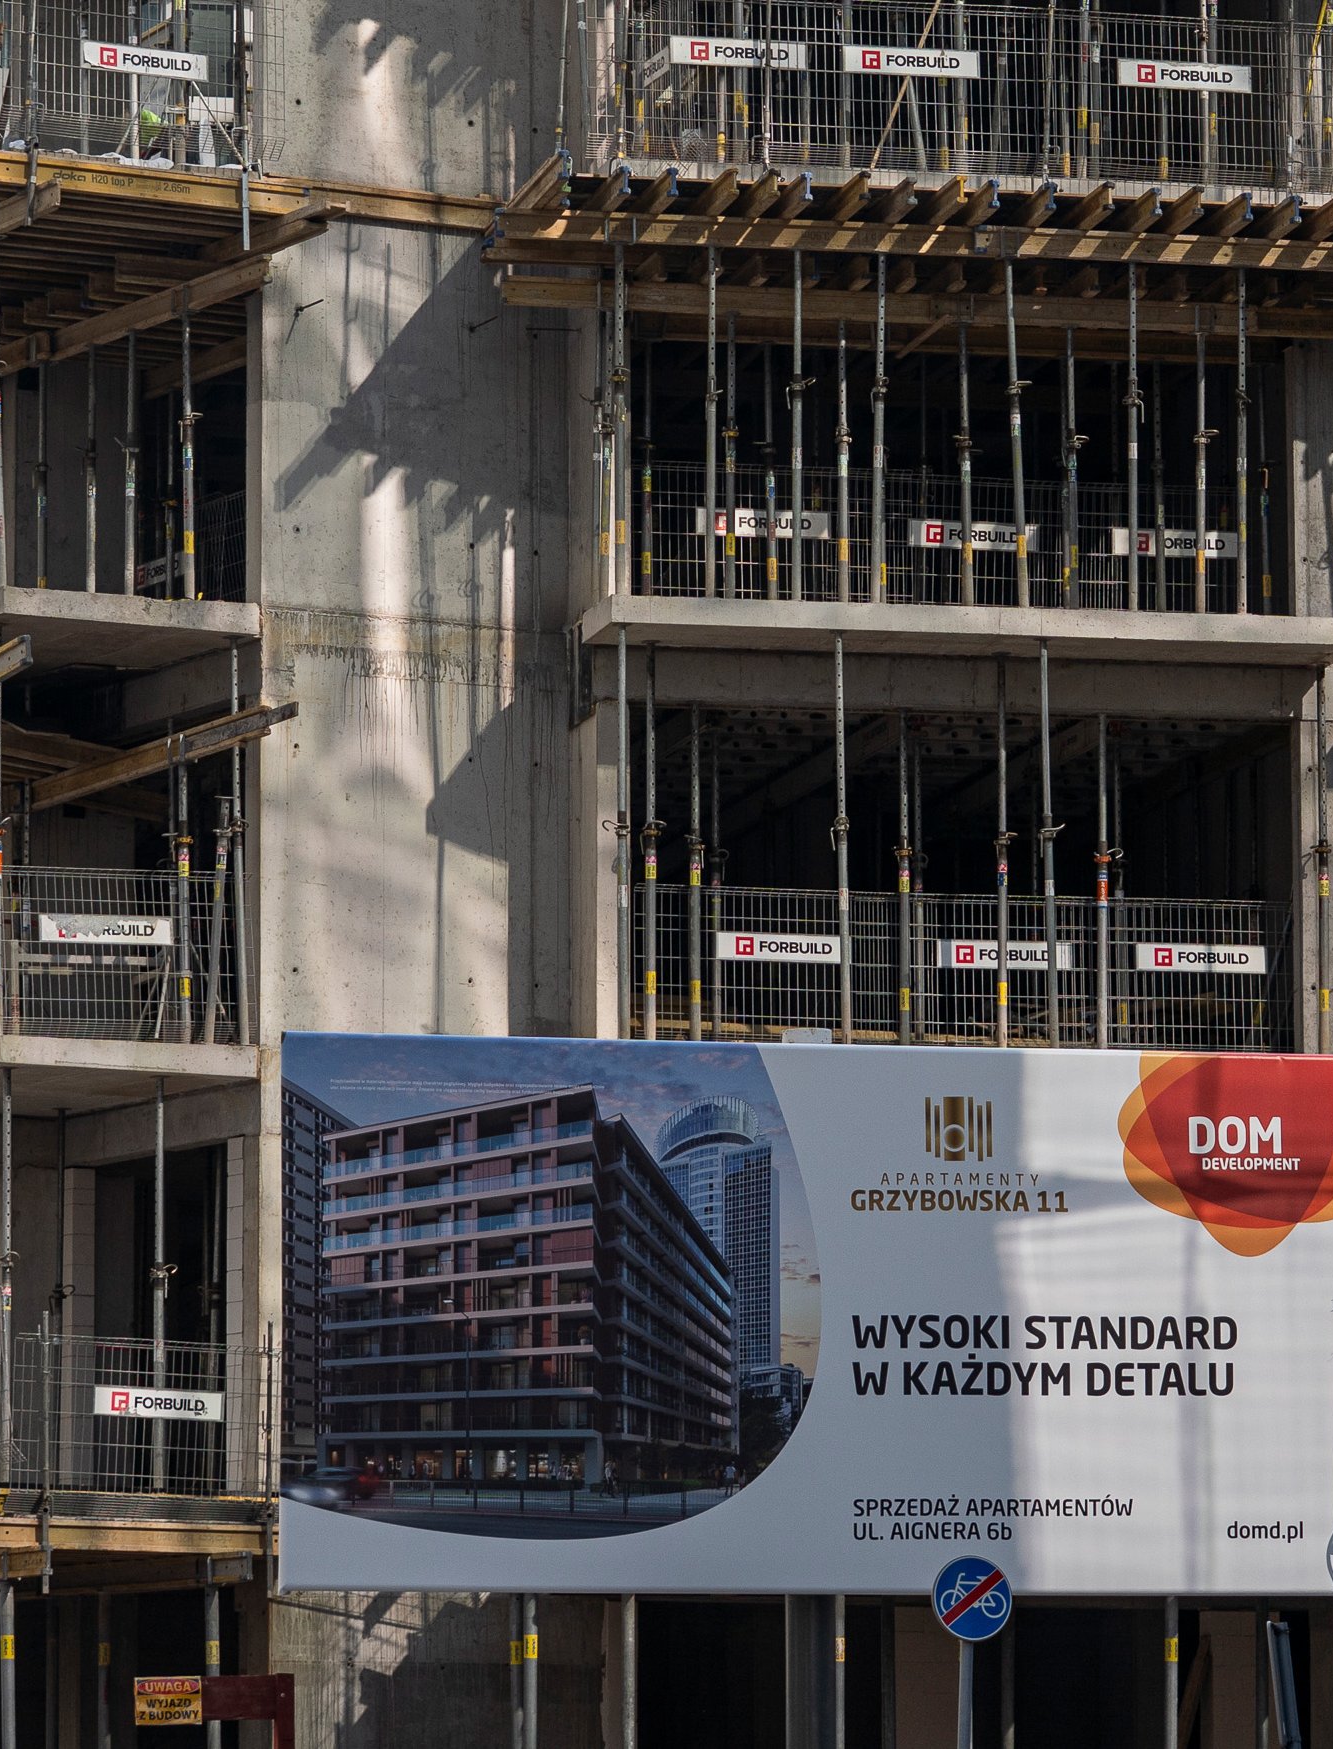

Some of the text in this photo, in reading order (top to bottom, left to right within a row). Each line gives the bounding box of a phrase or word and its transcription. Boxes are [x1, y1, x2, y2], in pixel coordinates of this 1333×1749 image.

[714, 46, 789, 62] FORBULD
[122, 52, 192, 73] FORBUILD
[886, 55, 961, 70] FORBUILD
[1160, 69, 1233, 84] FORBUILD
[53, 171, 86, 181] doka
[91, 174, 108, 185] H20
[102, 924, 155, 938] RBUILD
[759, 940, 832, 956] FORBUILD
[1178, 951, 1249, 966] FORBUILD
[1188, 1116, 1283, 1155] DOM
[1202, 1157, 1301, 1171] DEVELOPMENT
[880, 1172, 1040, 1187] APARTAMENTY
[850, 1189, 1068, 1213] GRZYBOWSKA 11
[852, 1314, 1238, 1350] WYSOKI STANDARD
[852, 1353, 1235, 1397] W KAŻDYM DETALU
[134, 1396, 206, 1413] FORBUILD
[853, 1493, 1133, 1517] SPRZEDAŻ APARTAMENTÓW
[853, 1521, 1013, 1541] UL. AIGNERA 6b
[1227, 1521, 1304, 1544] domd.pl
[145, 1681, 192, 1692] UWAGA
[146, 1698, 192, 1709] WYJAZD
[139, 1710, 199, 1720] Z BUDOWY
